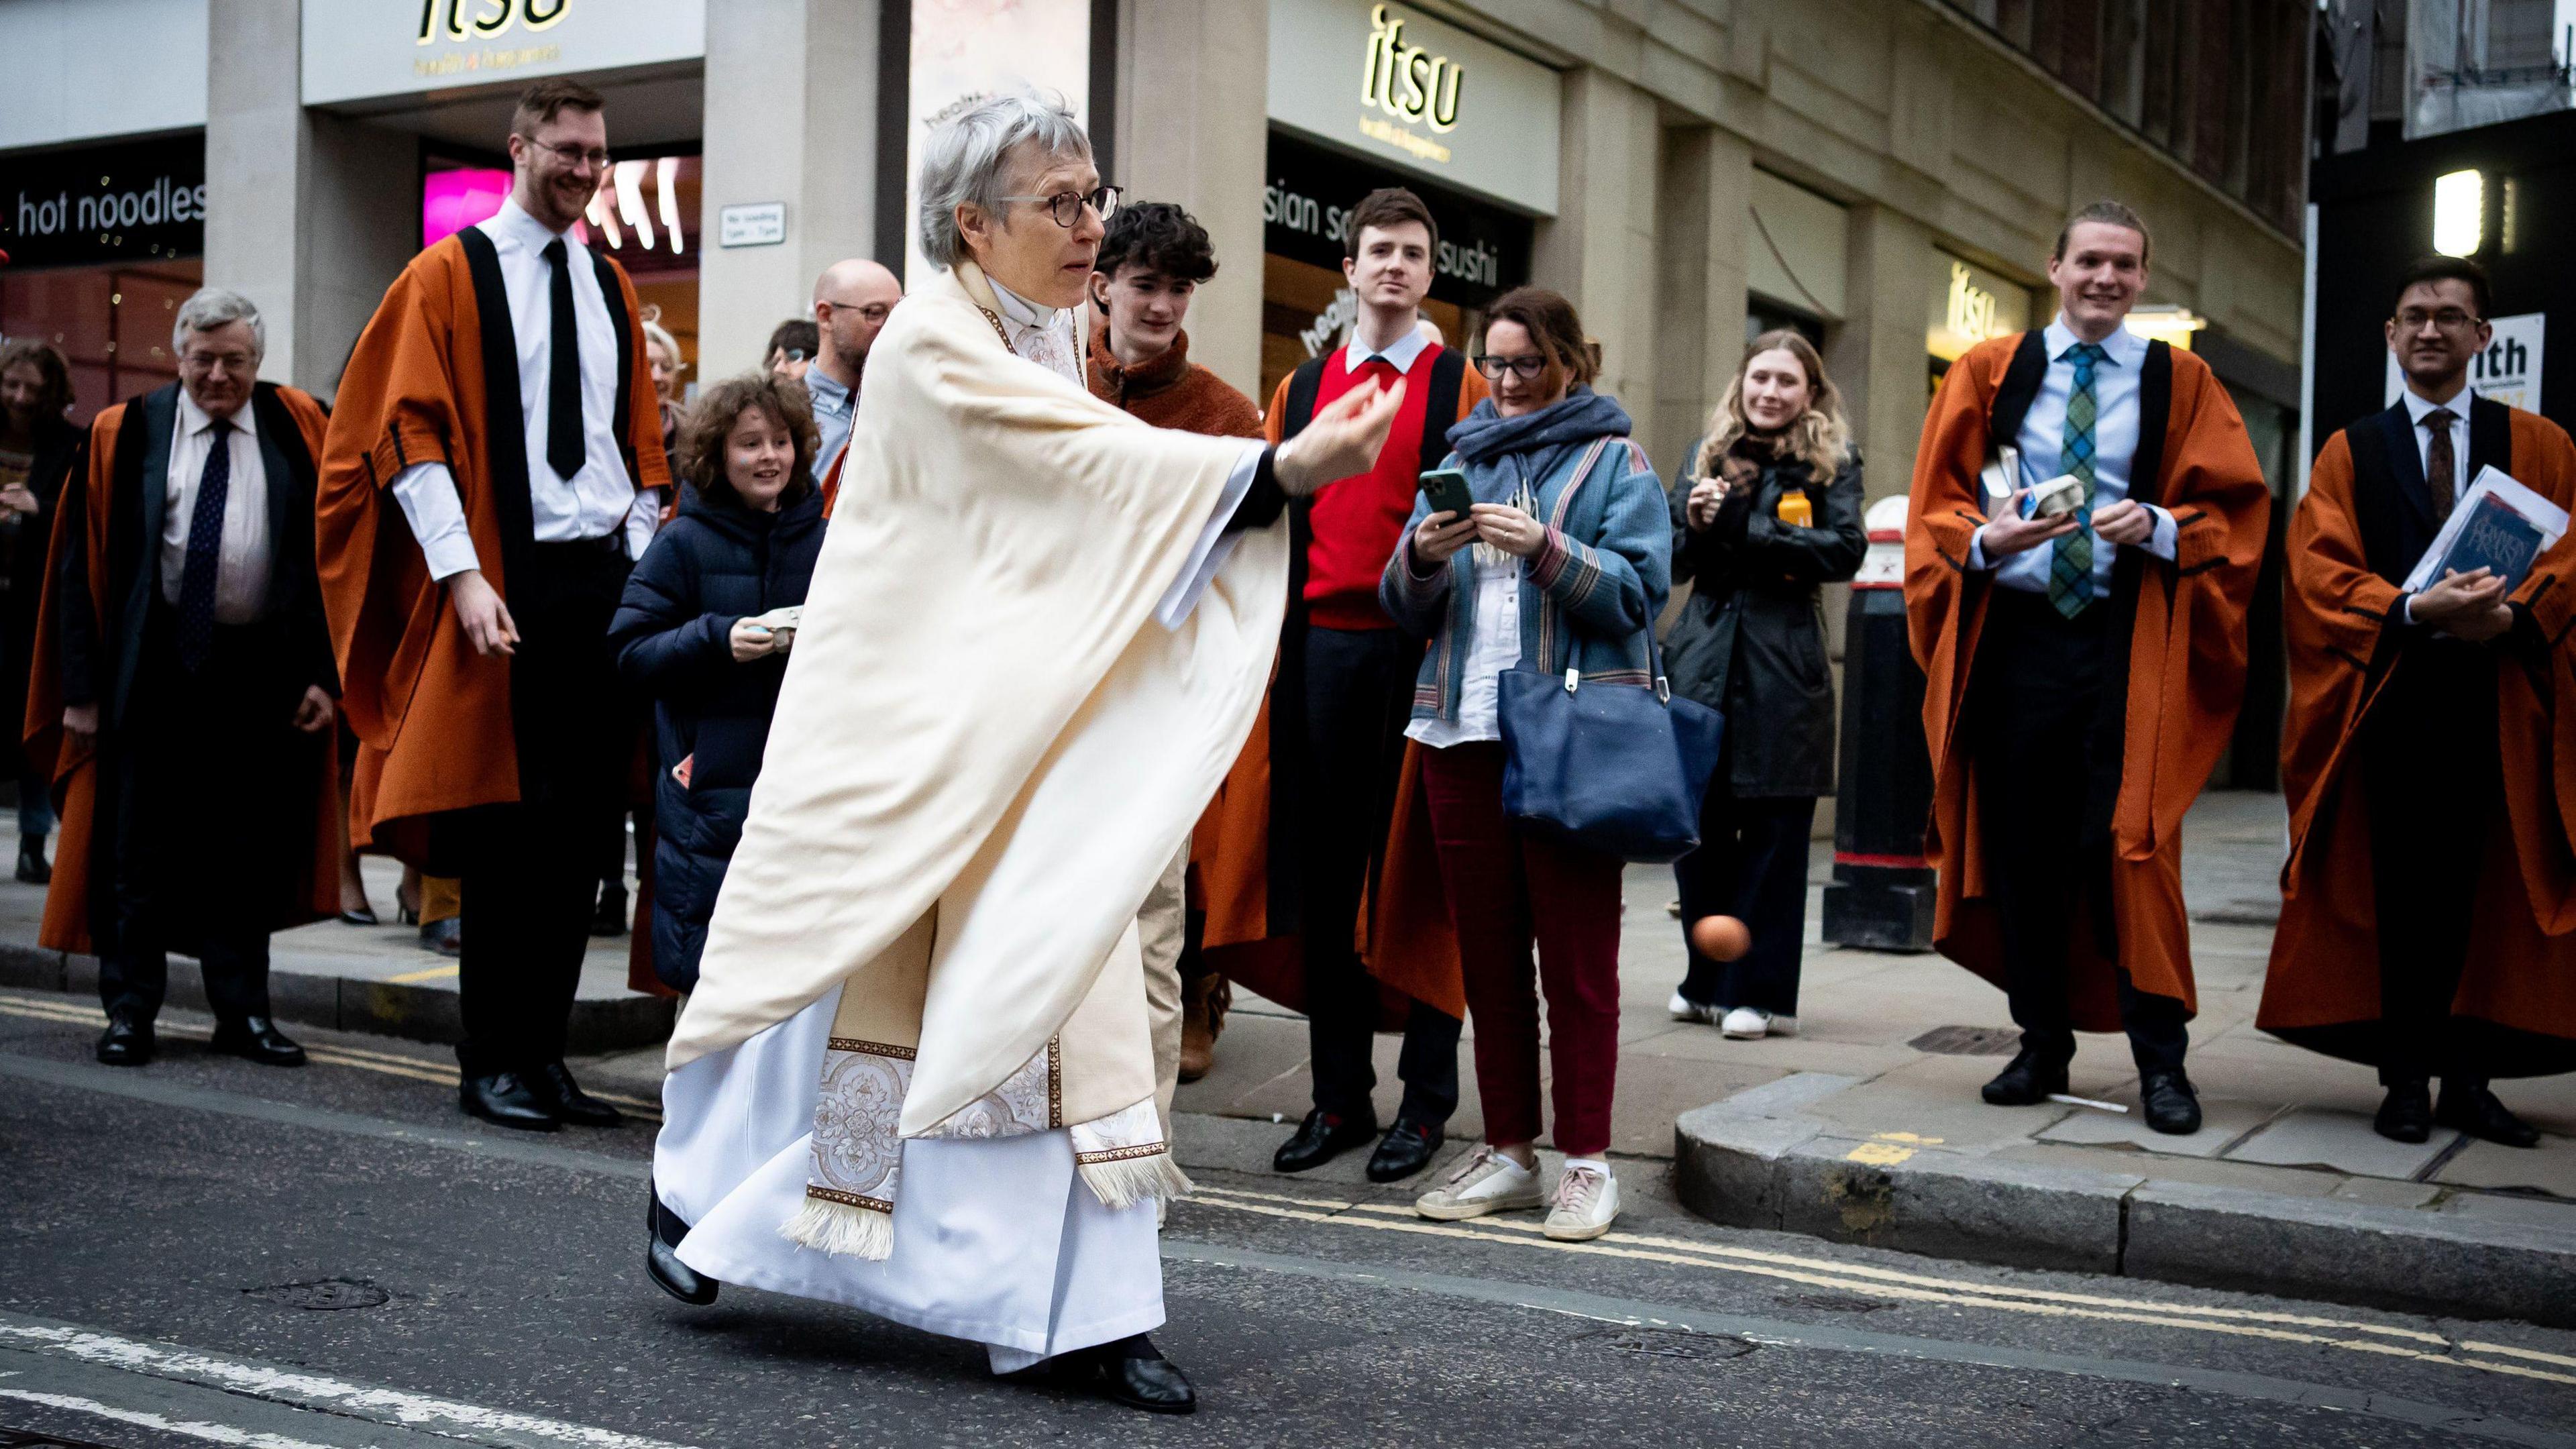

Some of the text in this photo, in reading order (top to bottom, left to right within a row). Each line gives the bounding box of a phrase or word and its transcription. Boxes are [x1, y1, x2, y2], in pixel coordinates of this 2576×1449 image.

[1361, 4, 1462, 134] itsu
[18, 175, 207, 237] hot noodles
[1264, 178, 1319, 235] sian
[1437, 239, 1497, 287] sushi
[1947, 260, 1995, 339] itsu
